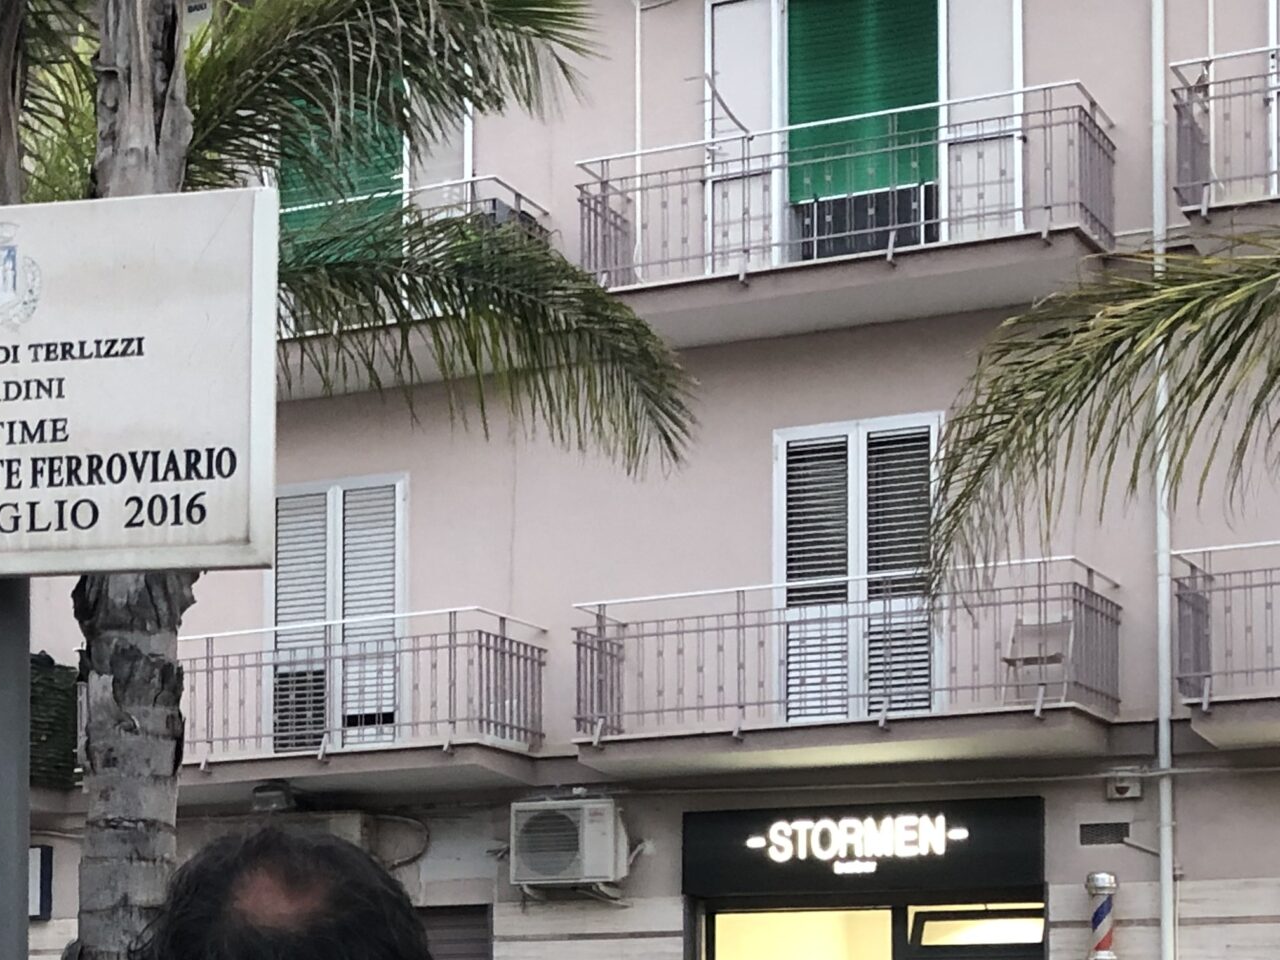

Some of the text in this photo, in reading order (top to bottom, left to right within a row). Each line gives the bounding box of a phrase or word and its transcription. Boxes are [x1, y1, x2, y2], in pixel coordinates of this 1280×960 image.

[27, 336, 145, 362] TERLIZZI
[30, 446, 237, 489] FERROVIARIO
[124, 491, 207, 529] 2016
